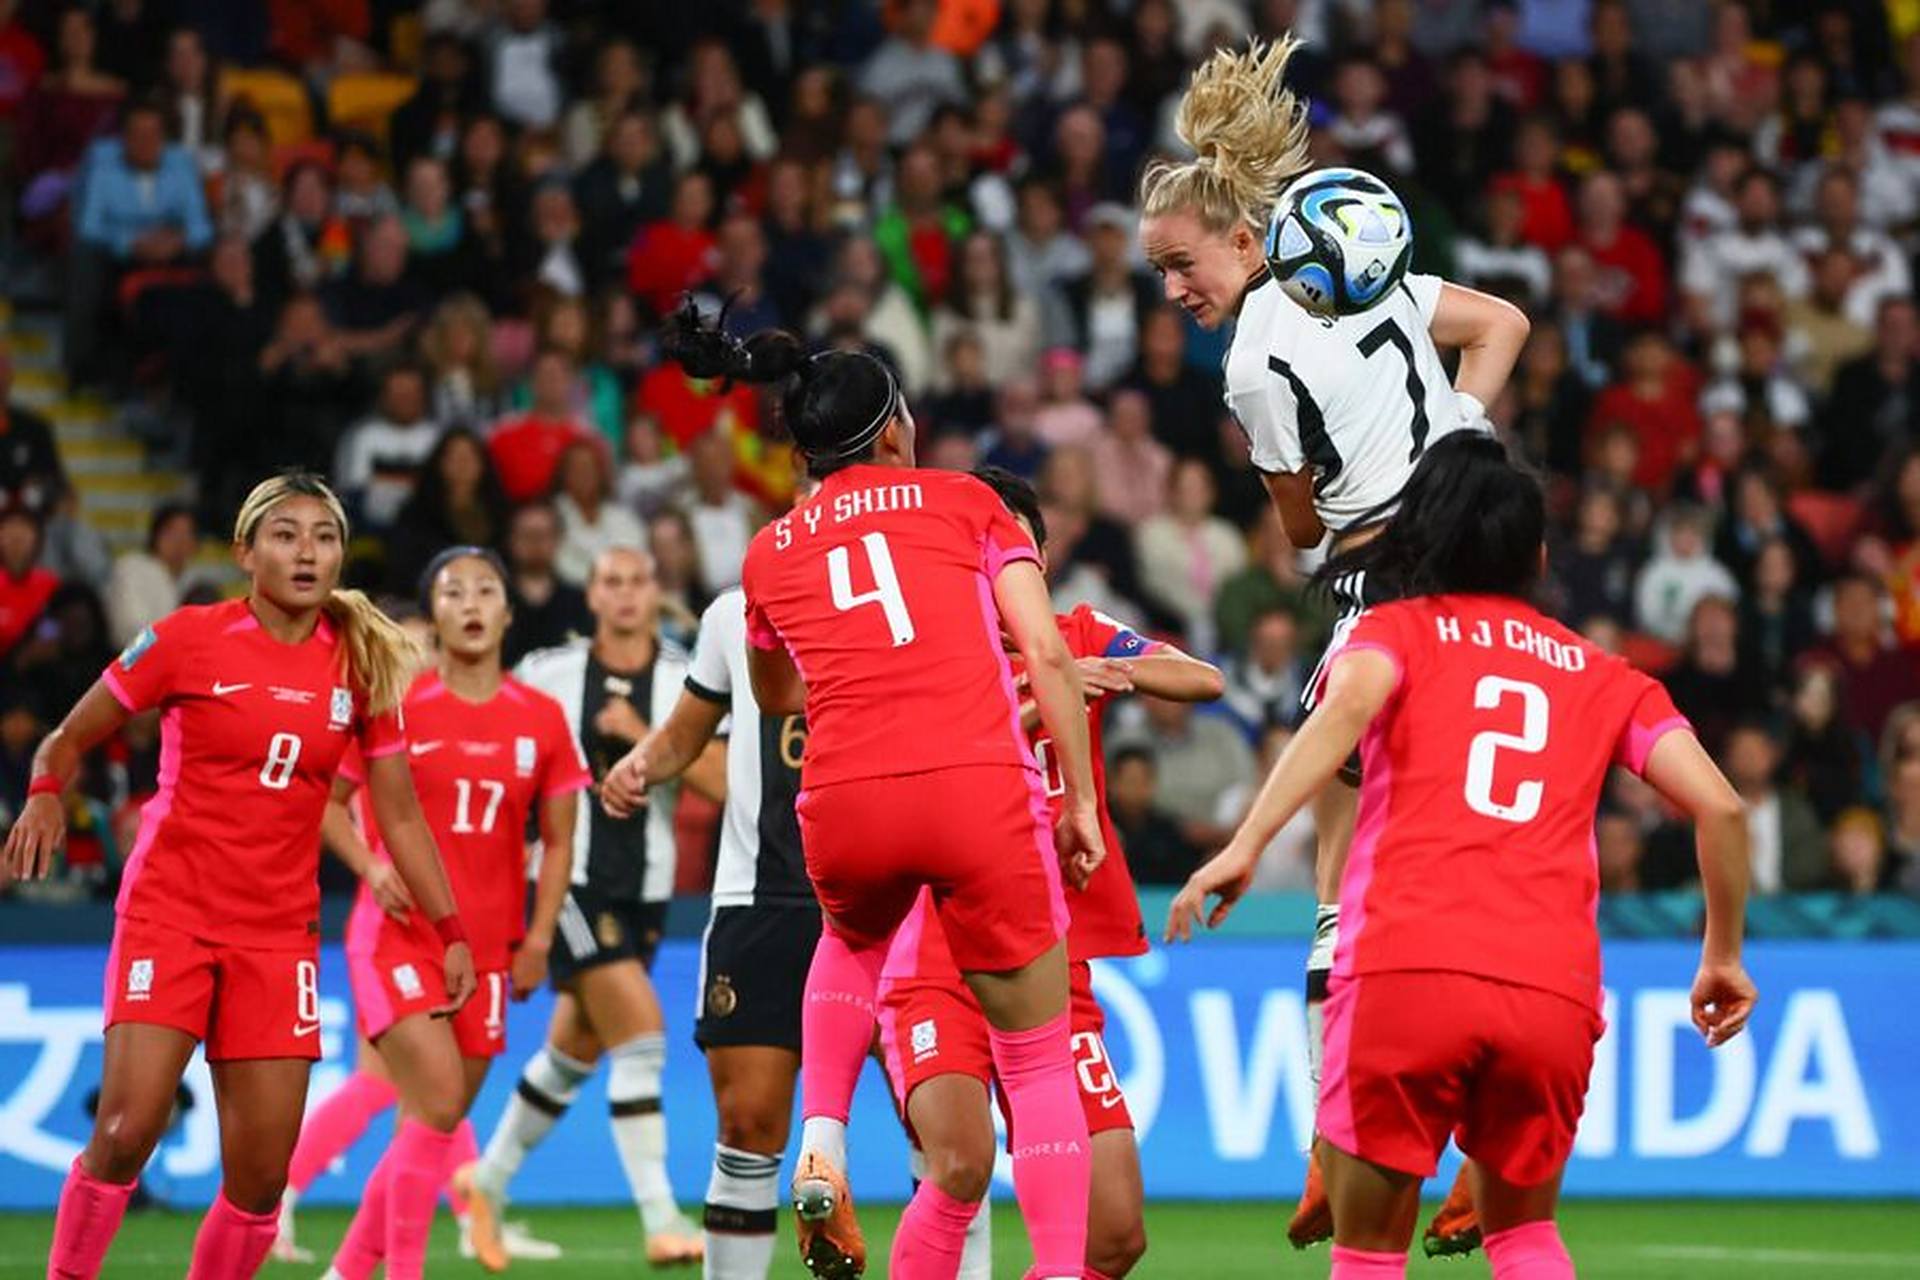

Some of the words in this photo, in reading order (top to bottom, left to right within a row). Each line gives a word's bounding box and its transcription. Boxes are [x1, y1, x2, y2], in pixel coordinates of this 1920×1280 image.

[1356, 317, 1431, 464] 7
[775, 518, 793, 551] S
[804, 505, 822, 535] Y
[834, 484, 923, 523] SHIM
[827, 531, 915, 647] 4
[1436, 616, 1461, 643] H
[1471, 620, 1493, 648] J
[1504, 619, 1585, 672] CHOO
[259, 732, 302, 790] 8
[781, 714, 806, 769] 6
[1464, 675, 1550, 823] 2
[451, 778, 505, 834] 17
[296, 960, 319, 1021] 8
[483, 972, 508, 1027] 1
[1070, 1031, 1119, 1093] 2
[1188, 988, 1881, 1159] WDA
